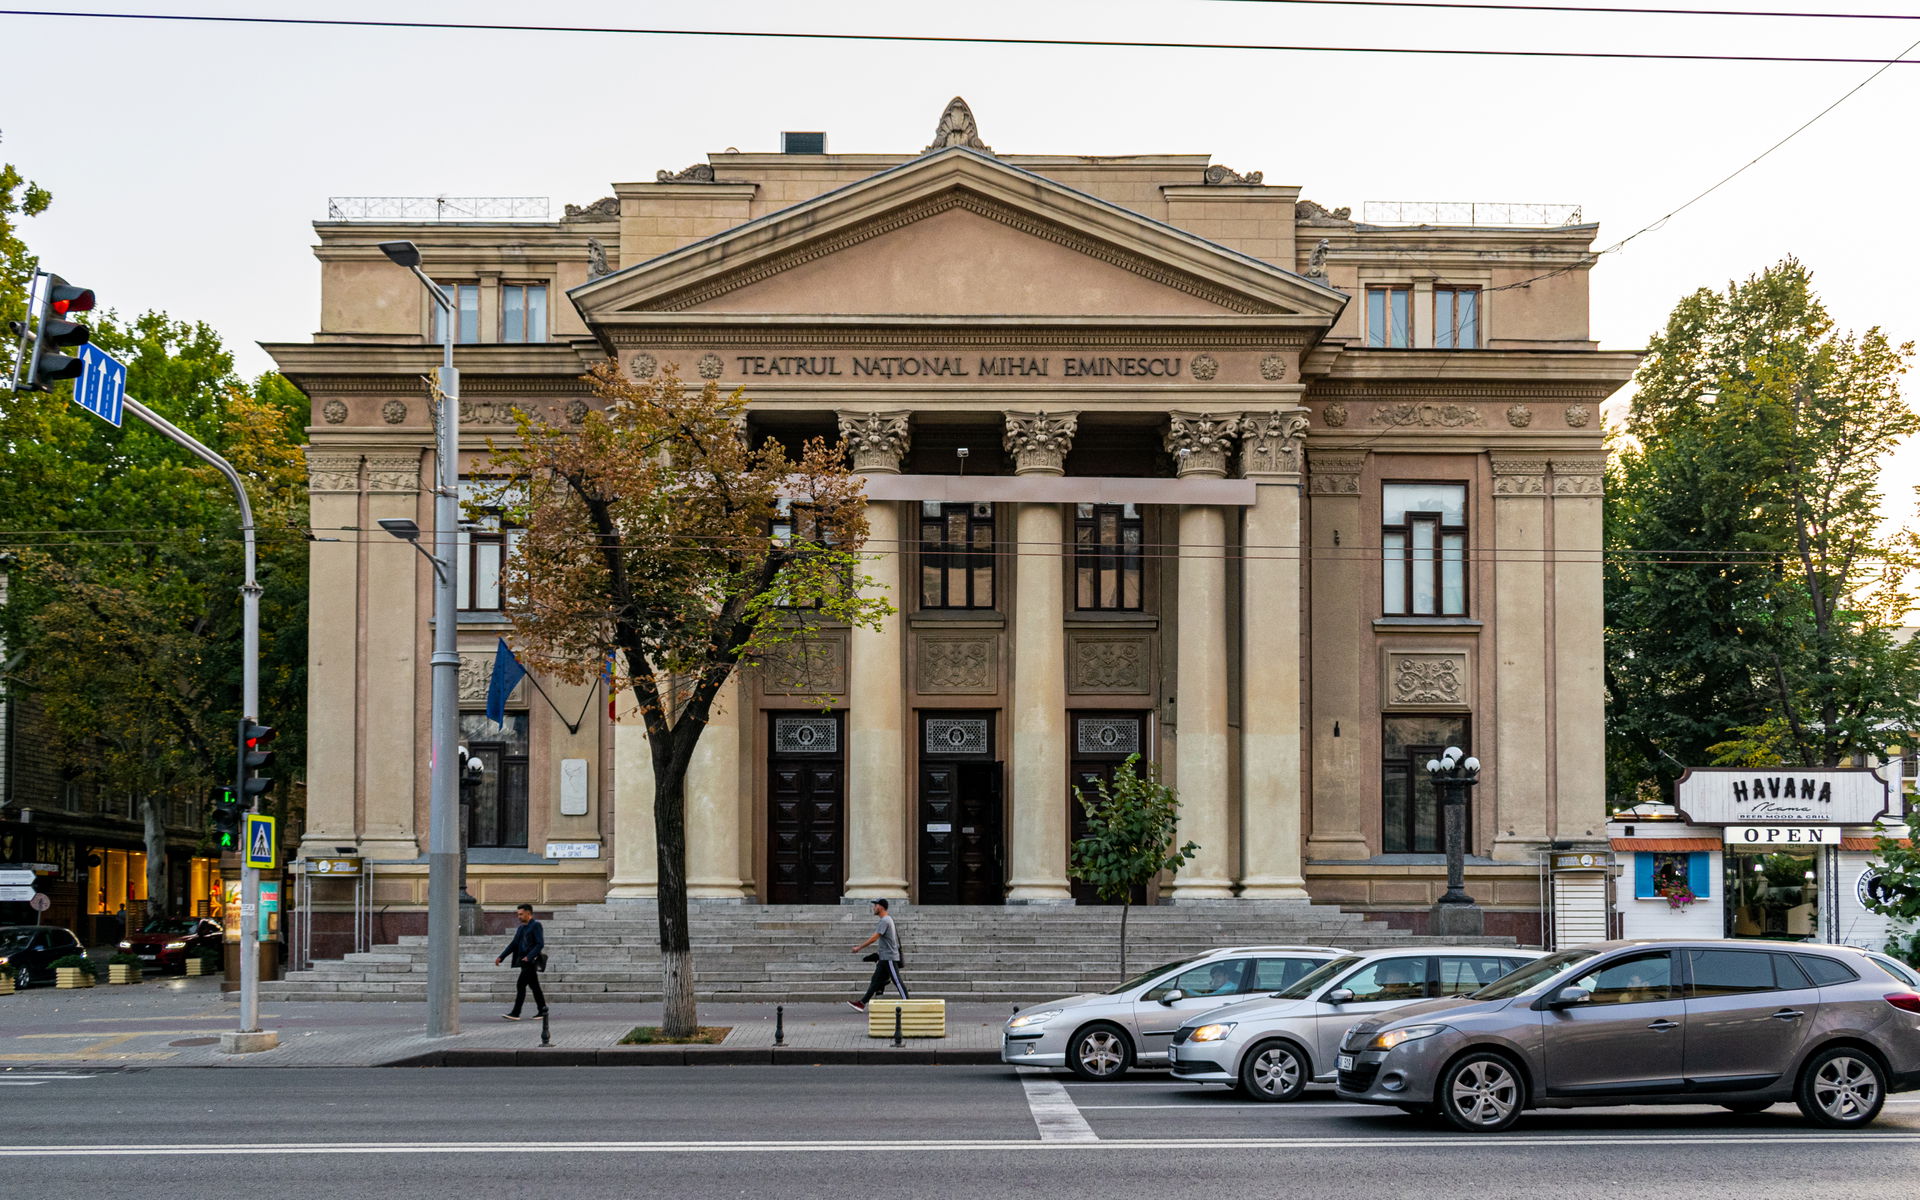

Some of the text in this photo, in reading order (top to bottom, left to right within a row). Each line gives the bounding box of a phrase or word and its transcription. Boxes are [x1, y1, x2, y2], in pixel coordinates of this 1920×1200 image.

[737, 356, 842, 376] TEATRUL
[978, 356, 1049, 377] MIHAI
[1063, 356, 1182, 377] EMINESCU
[1733, 777, 1831, 803] HAVANA
[1752, 801, 1812, 812] Mama
[1744, 828, 1823, 842] OPEN
